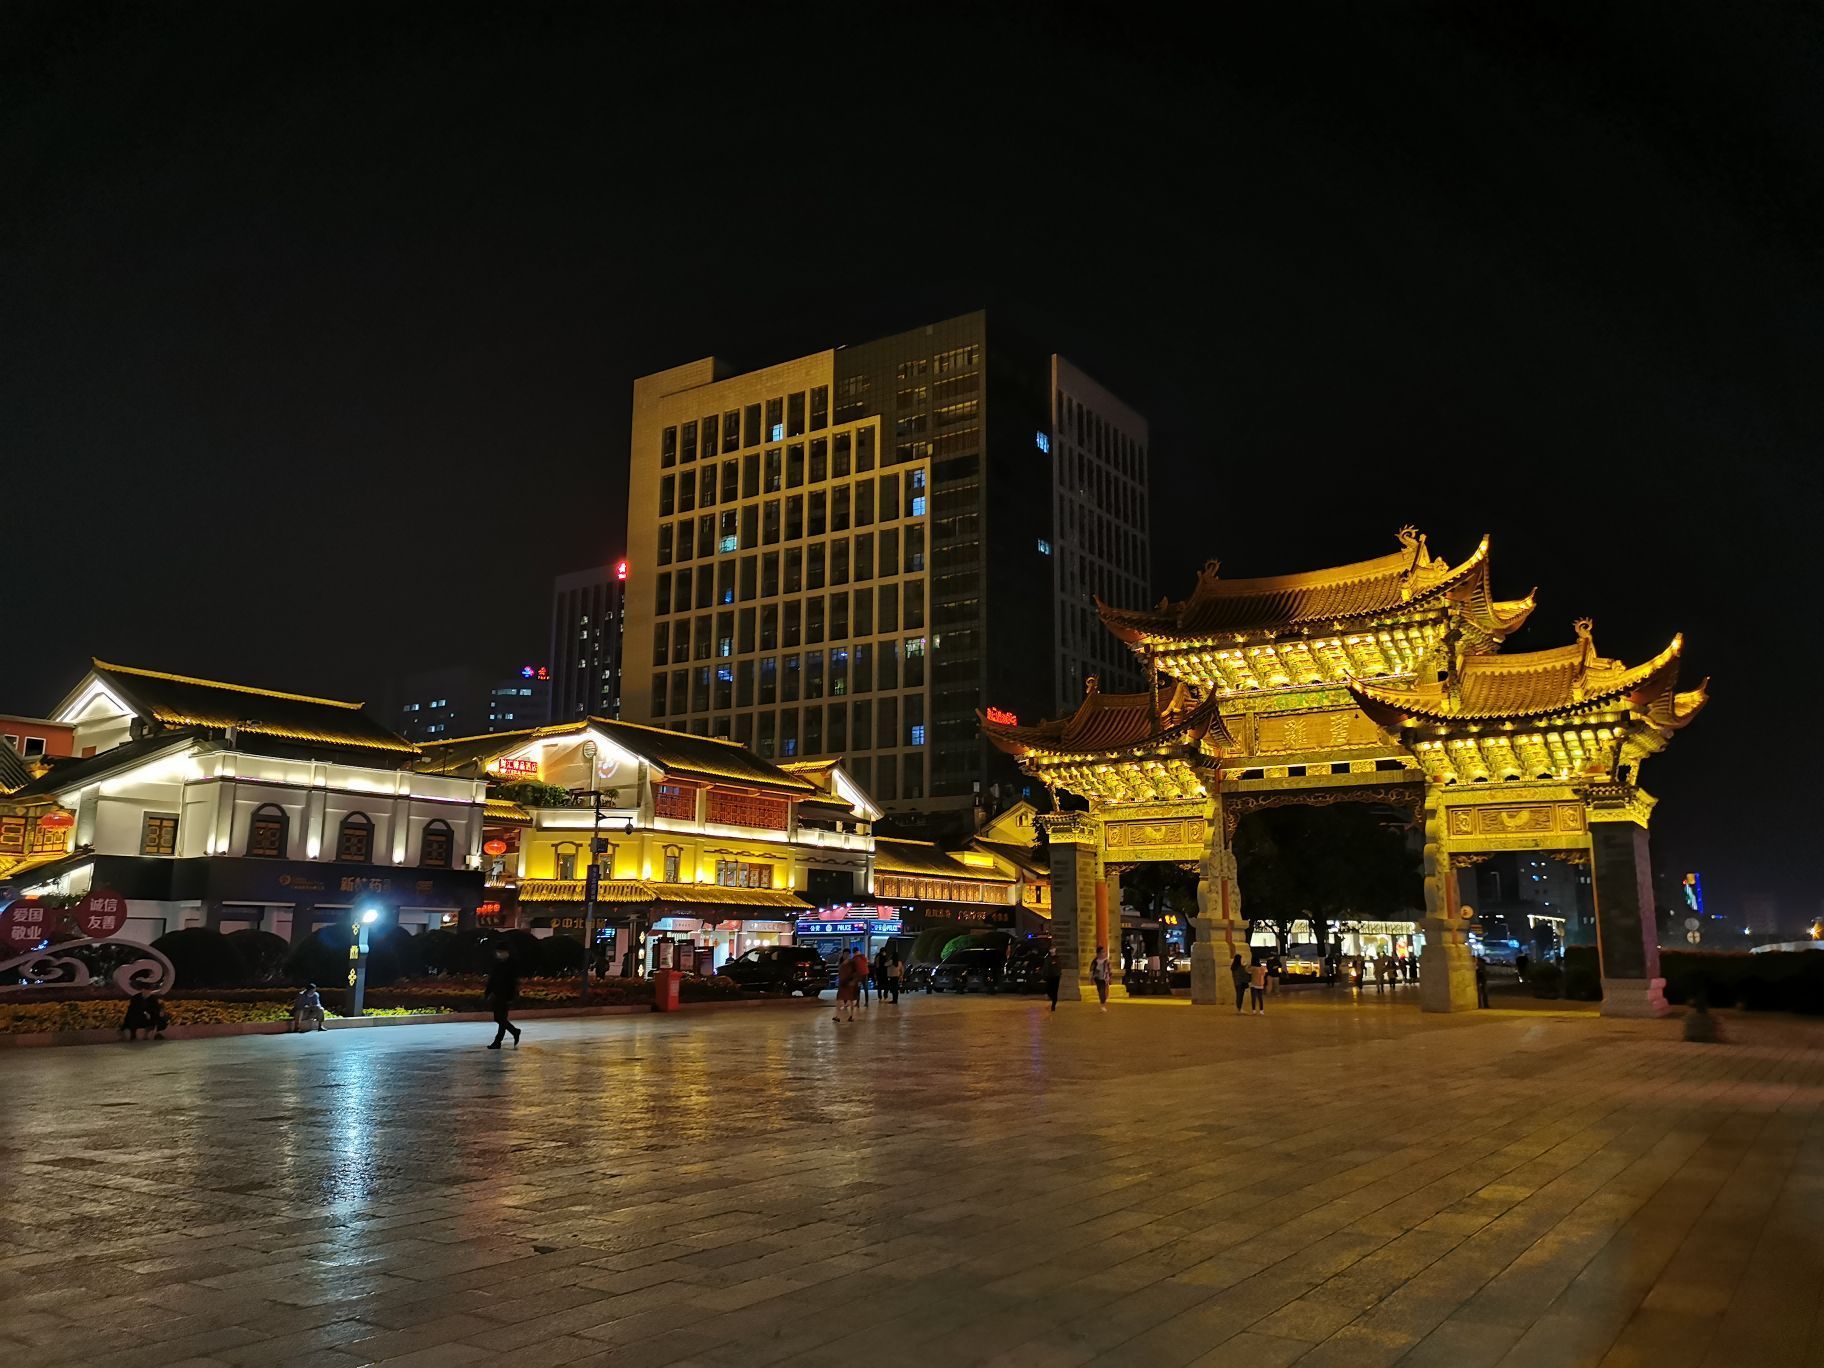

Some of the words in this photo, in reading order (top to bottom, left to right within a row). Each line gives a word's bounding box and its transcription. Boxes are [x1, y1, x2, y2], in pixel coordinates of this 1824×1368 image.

[91, 898, 118, 912] 诚信
[13, 908, 43, 922] 爱国
[88, 916, 115, 929] 友善
[11, 926, 42, 940] 敬业
